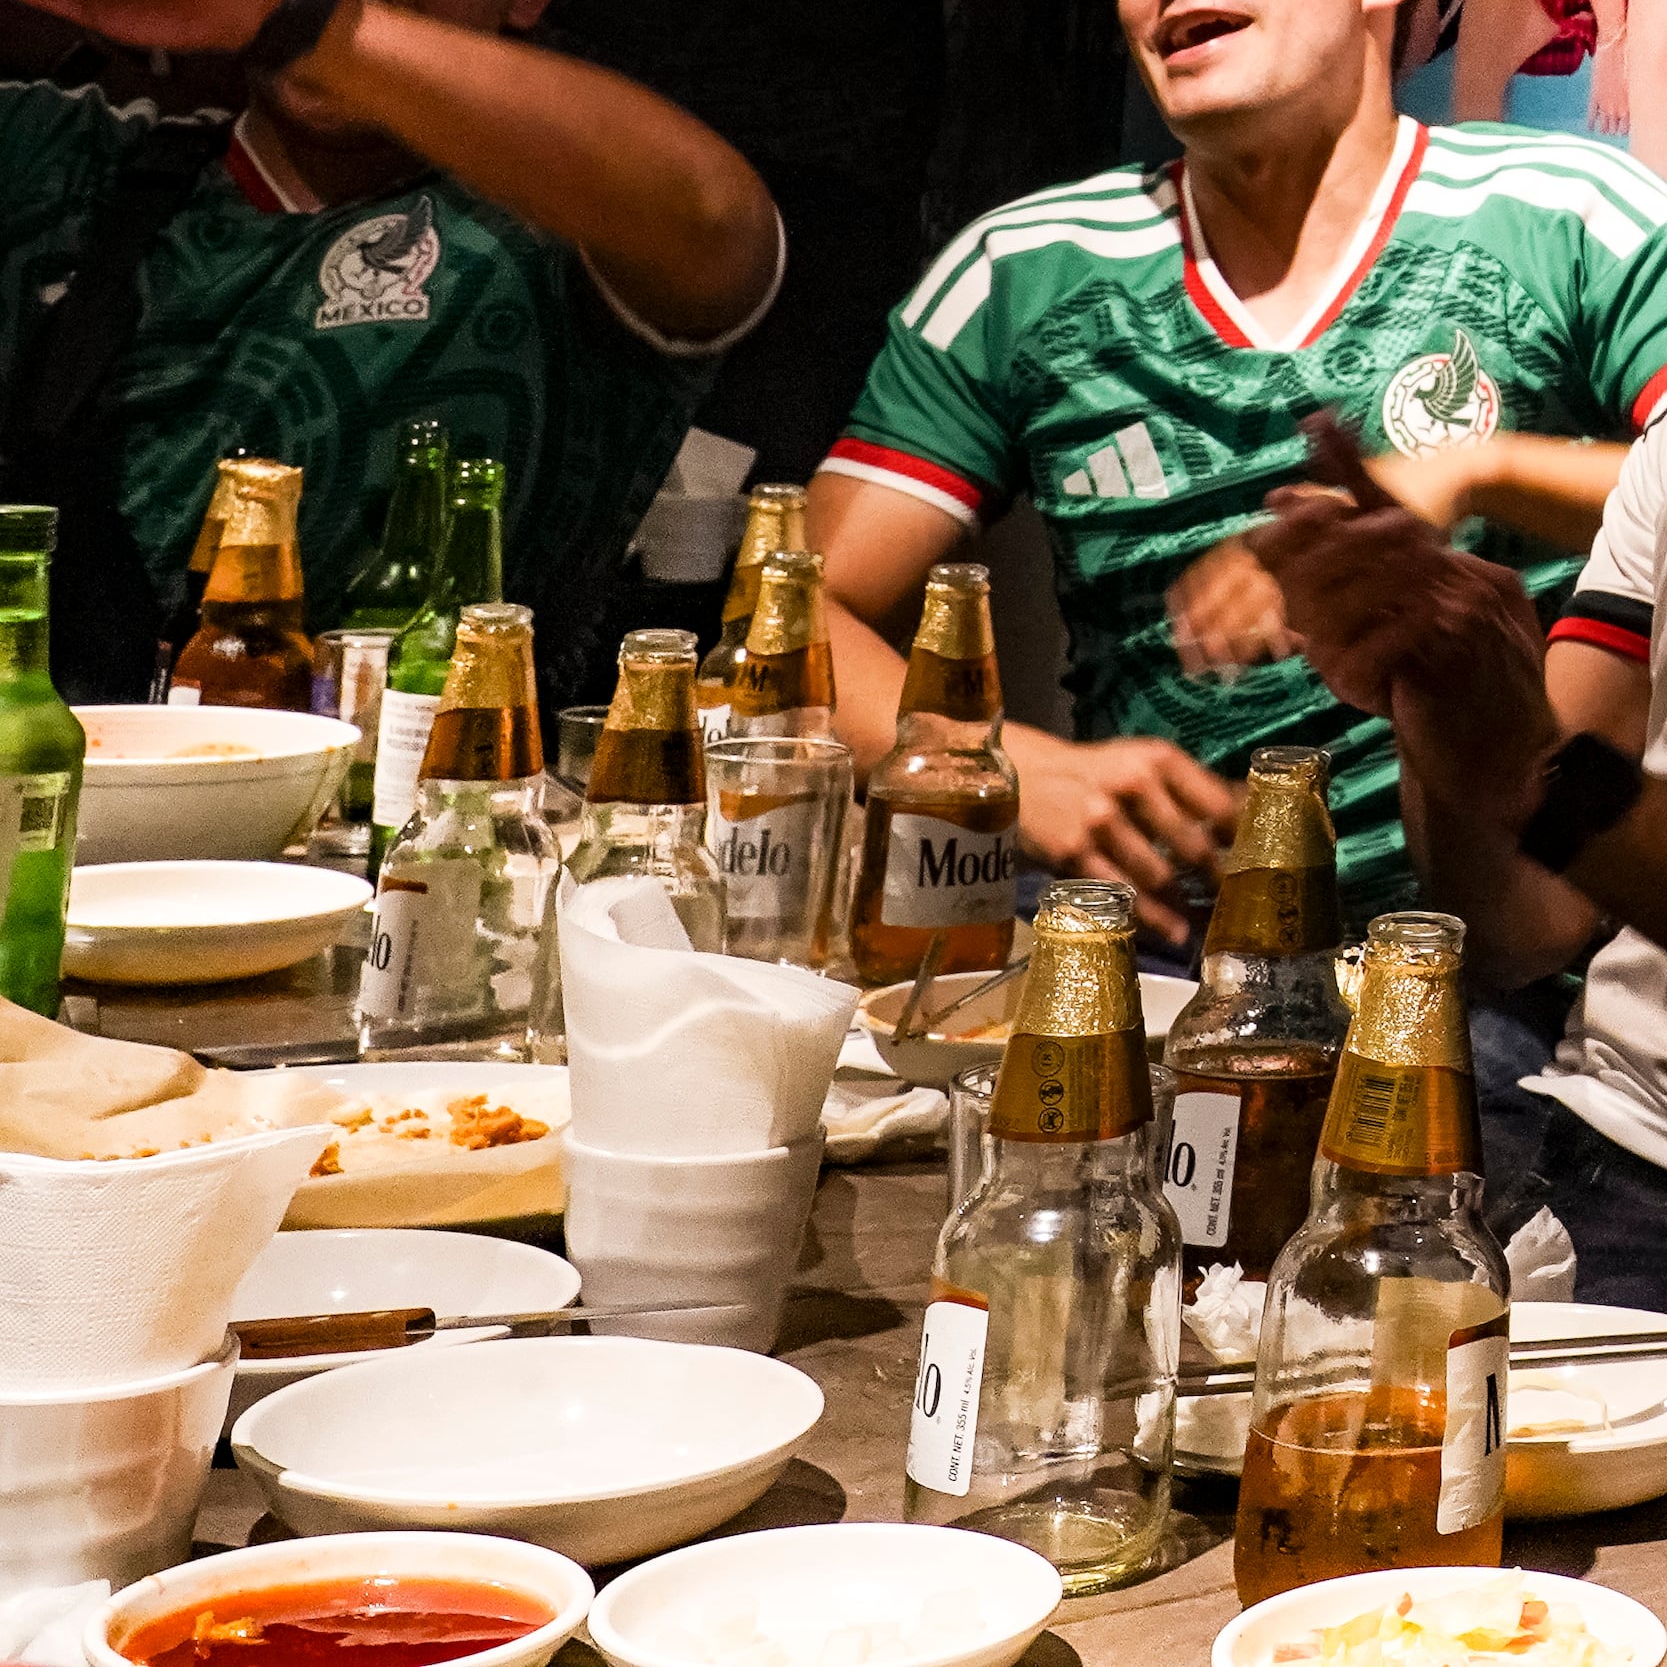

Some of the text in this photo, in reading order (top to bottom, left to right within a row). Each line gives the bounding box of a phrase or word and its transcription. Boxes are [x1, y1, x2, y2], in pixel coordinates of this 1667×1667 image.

[959, 1399, 970, 1412] ml
[955, 1413, 968, 1432] 355
[952, 1433, 965, 1453] NET.
[947, 1456, 960, 1482] CONT.
